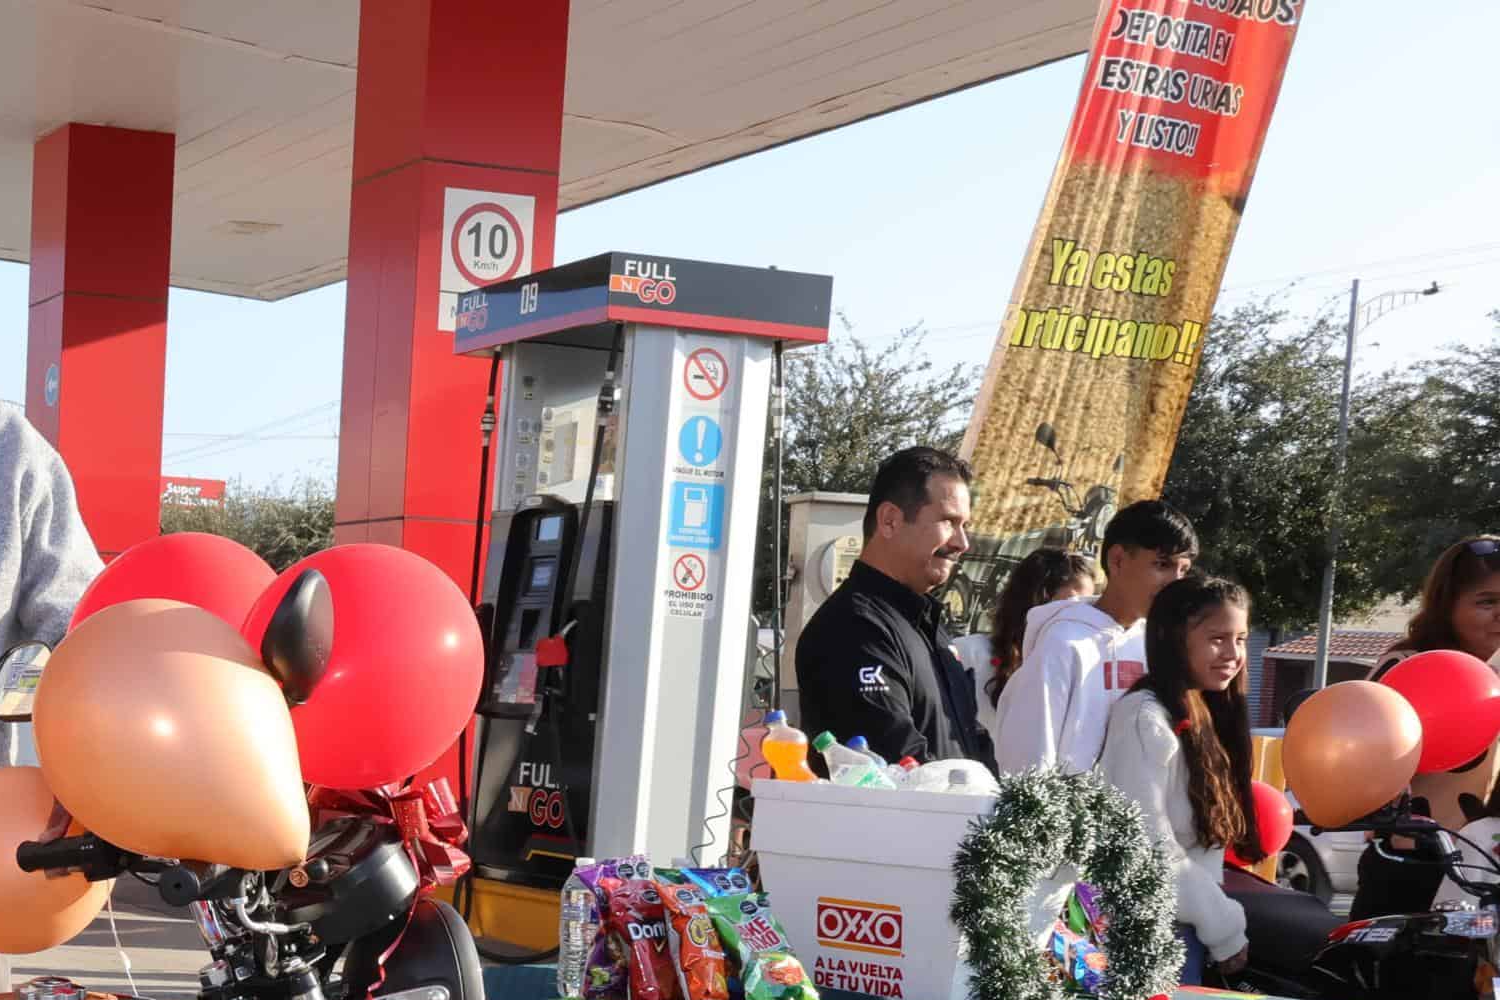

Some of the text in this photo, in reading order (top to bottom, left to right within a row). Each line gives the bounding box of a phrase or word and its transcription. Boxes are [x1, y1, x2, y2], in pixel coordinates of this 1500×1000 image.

[1117, 109, 1199, 156] Y LISTO!!
[467, 221, 509, 260] 10
[624, 259, 677, 281] FULL
[1049, 237, 1176, 297] Ya estas
[462, 292, 488, 312] FULL
[621, 278, 677, 305] N GO
[530, 789, 565, 828] GO
[819, 908, 901, 945] OXXO
[814, 970, 903, 999] DE TU VIDA
[815, 955, 903, 981] A LA VUELTA
